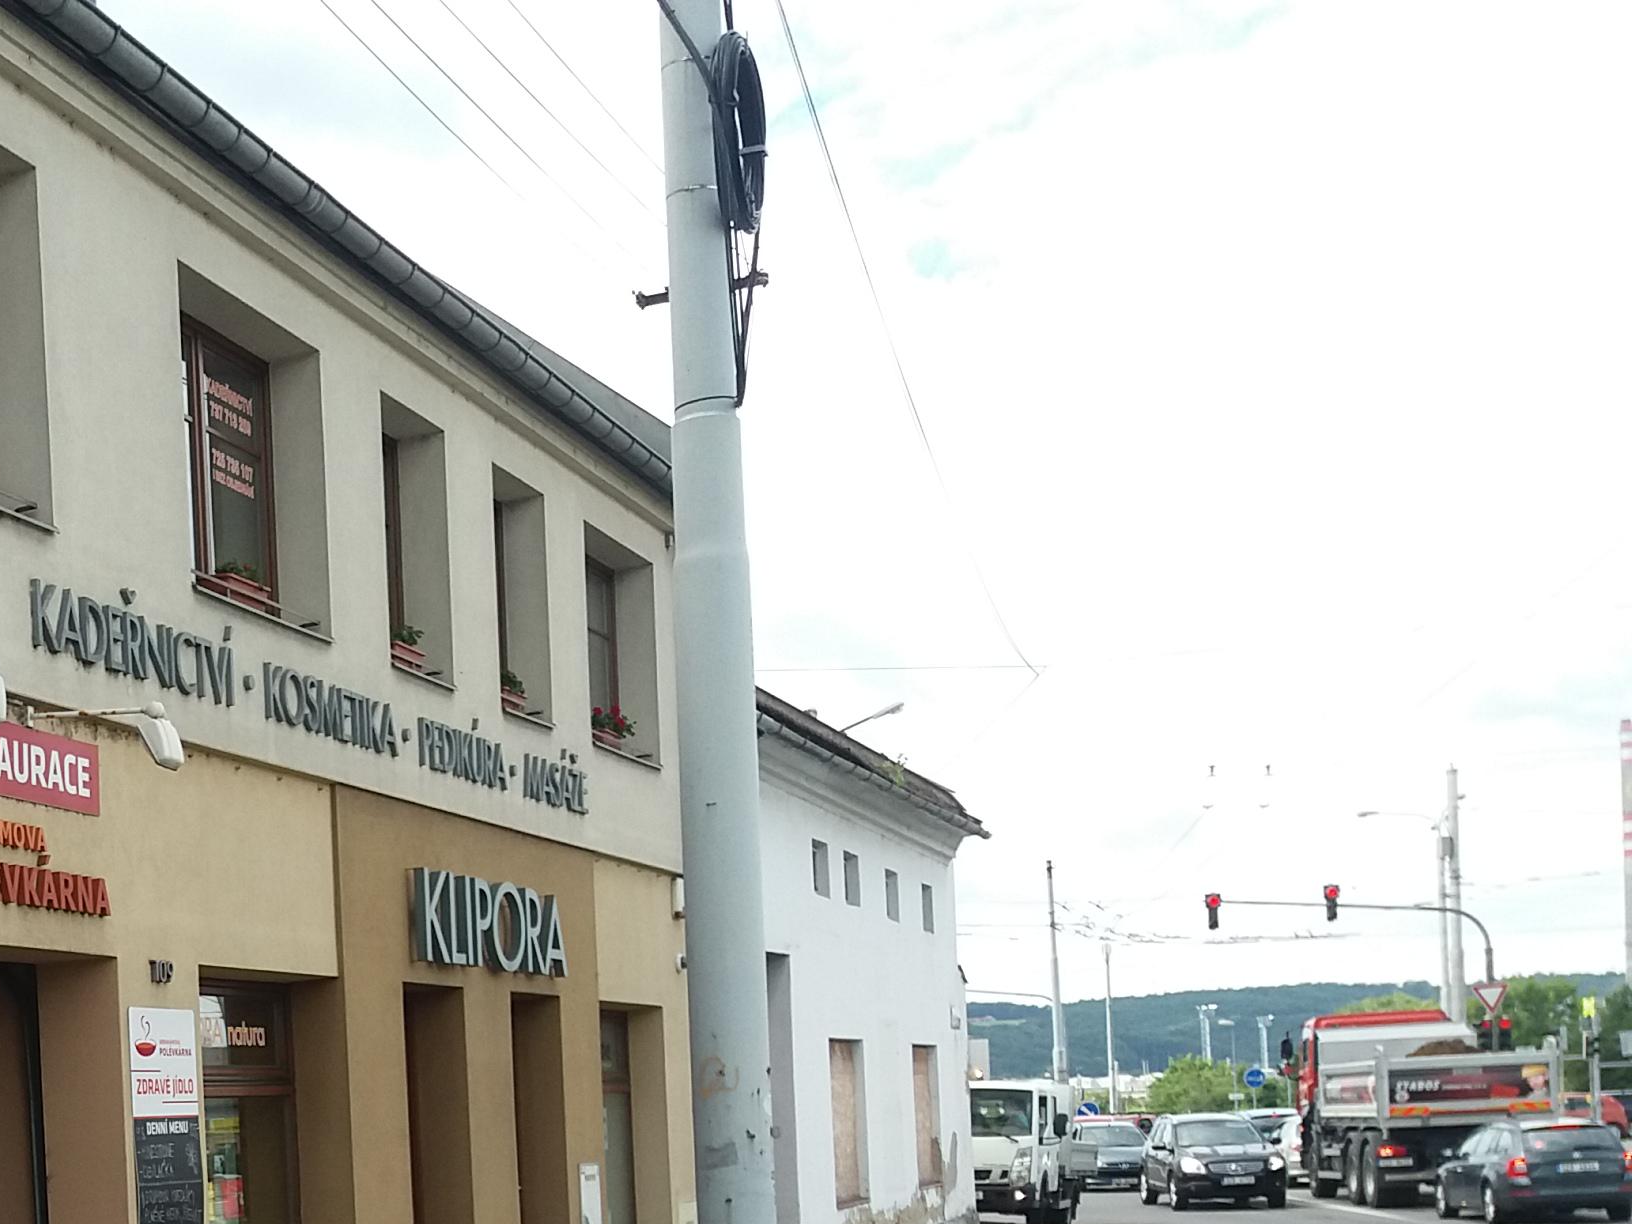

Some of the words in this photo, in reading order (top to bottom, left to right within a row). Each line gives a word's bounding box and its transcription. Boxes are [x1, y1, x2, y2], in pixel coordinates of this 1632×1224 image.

[30, 578, 235, 707] KADEŘNICTVÍ
[263, 661, 399, 758] KOSMETIKA
[418, 717, 508, 792] PEDIKÚRA
[524, 748, 590, 815] MASÁŽE
[408, 867, 568, 978] KLIPORA
[148, 960, 174, 984] 109
[227, 1020, 266, 1047] natura
[136, 1075, 171, 1095] ZDRAVÉ
[172, 1075, 194, 1098] JÍDLO
[146, 1118, 168, 1135] DENNÍ
[168, 1120, 189, 1135] MENU
